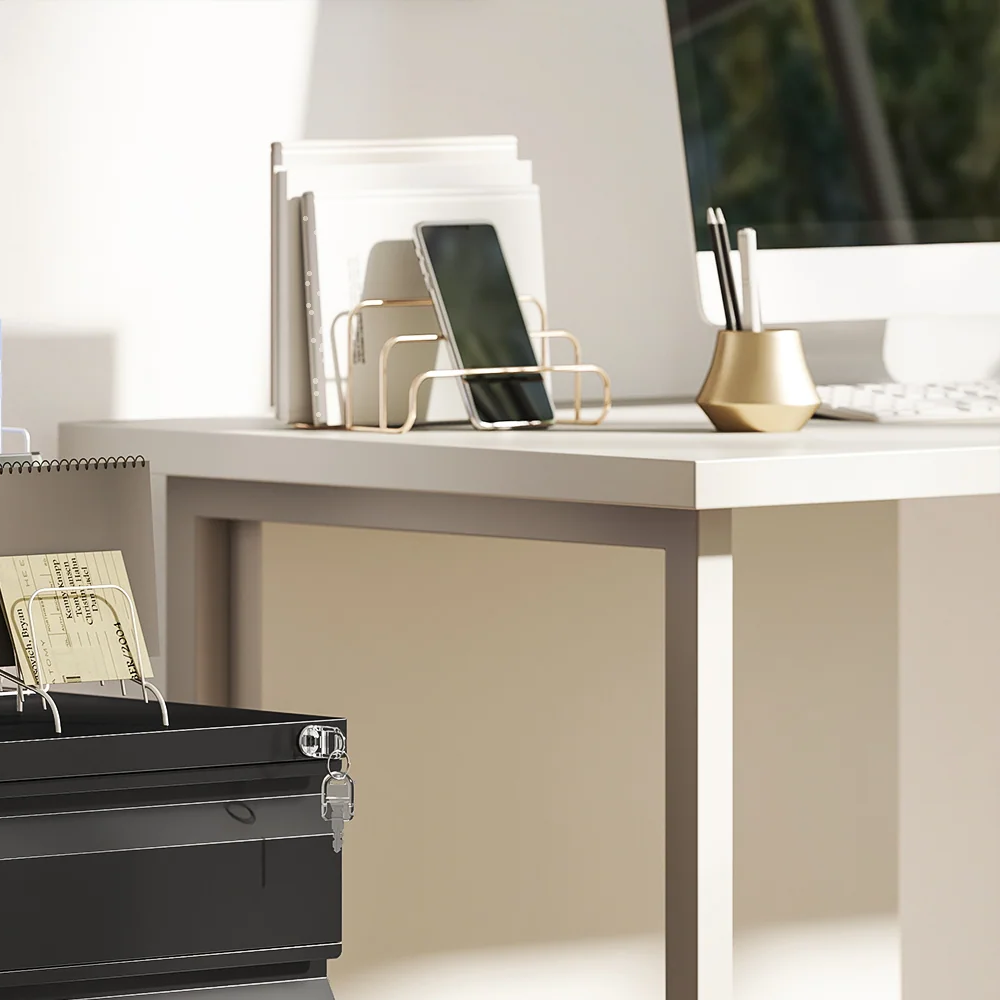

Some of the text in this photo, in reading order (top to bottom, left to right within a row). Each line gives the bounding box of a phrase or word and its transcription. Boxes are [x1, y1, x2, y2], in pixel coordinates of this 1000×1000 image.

[52, 559, 73, 619] Kenny Knapp
[71, 557, 94, 625] Christin Hahn
[89, 593, 99, 612] Dan
[73, 594, 83, 617] Tom
[17, 608, 29, 638] Bryan
